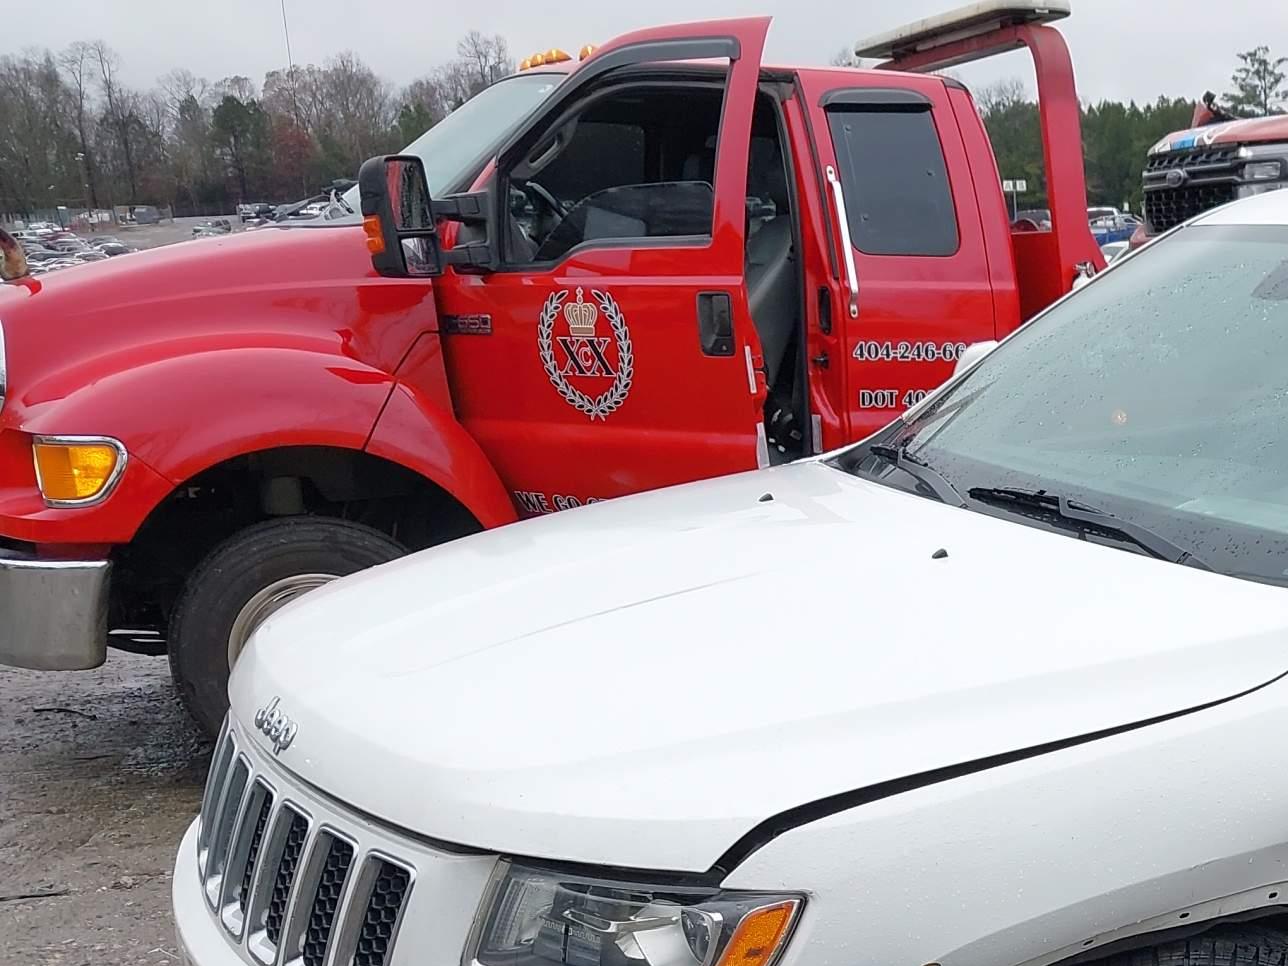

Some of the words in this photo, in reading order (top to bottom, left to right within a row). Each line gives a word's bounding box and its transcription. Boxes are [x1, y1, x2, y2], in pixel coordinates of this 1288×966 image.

[859, 389, 899, 408] DOT
[514, 490, 554, 513] WE
[254, 695, 299, 757] Jeep
